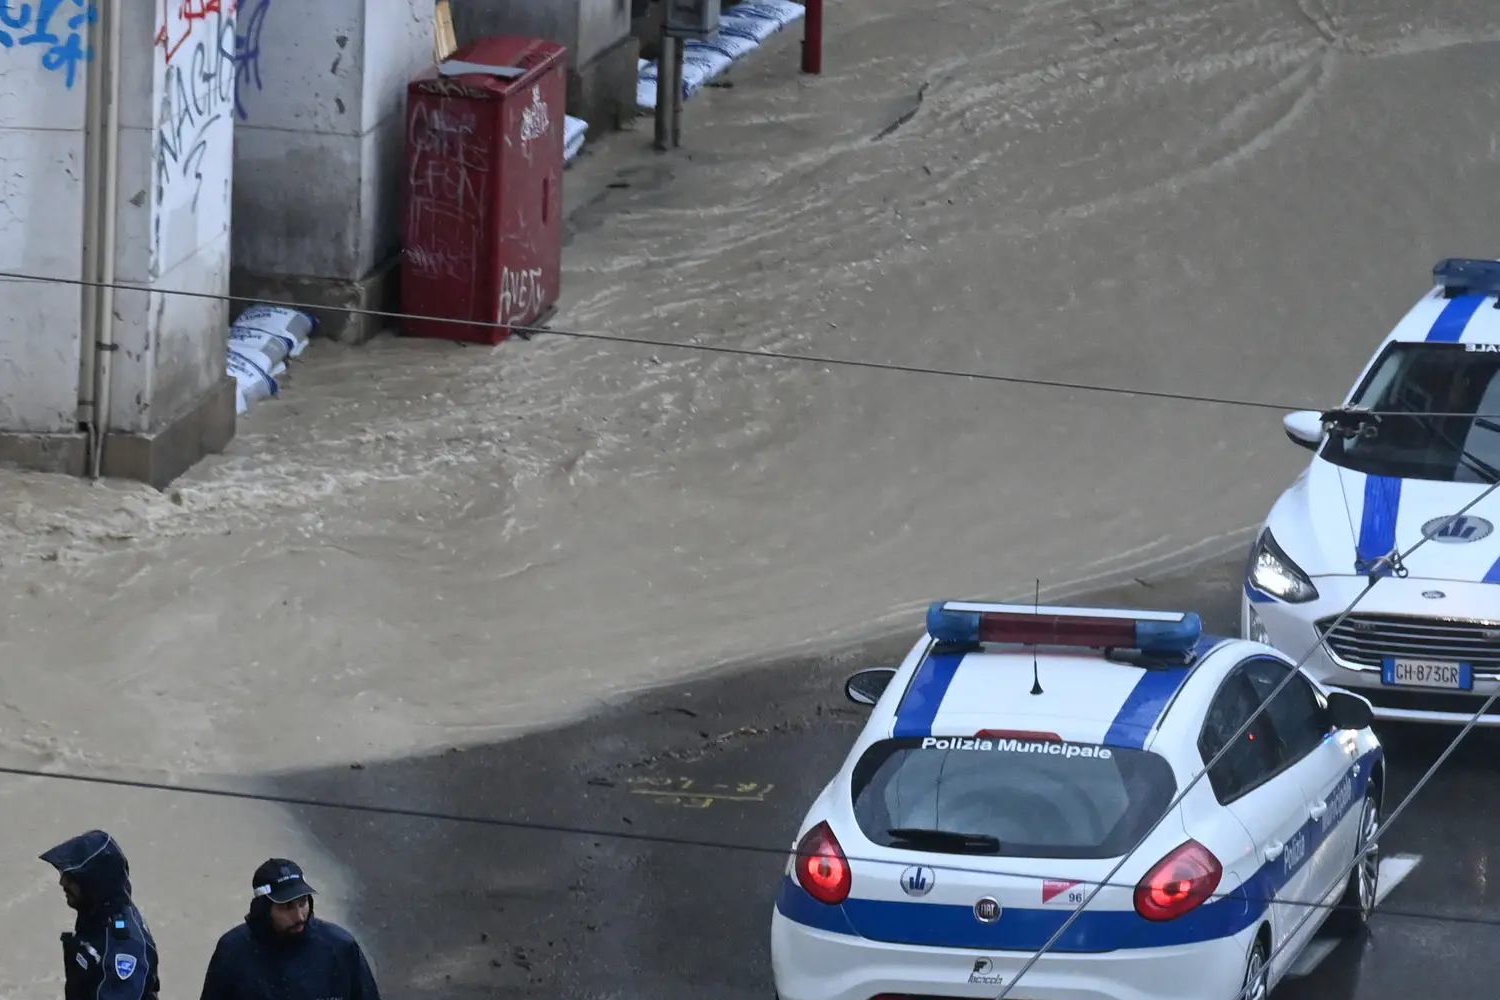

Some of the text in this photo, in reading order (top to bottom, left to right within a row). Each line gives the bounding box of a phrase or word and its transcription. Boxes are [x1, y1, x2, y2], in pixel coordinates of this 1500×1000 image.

[921, 737, 1113, 760] Polizia Municipale
[1068, 892, 1083, 904] 96
